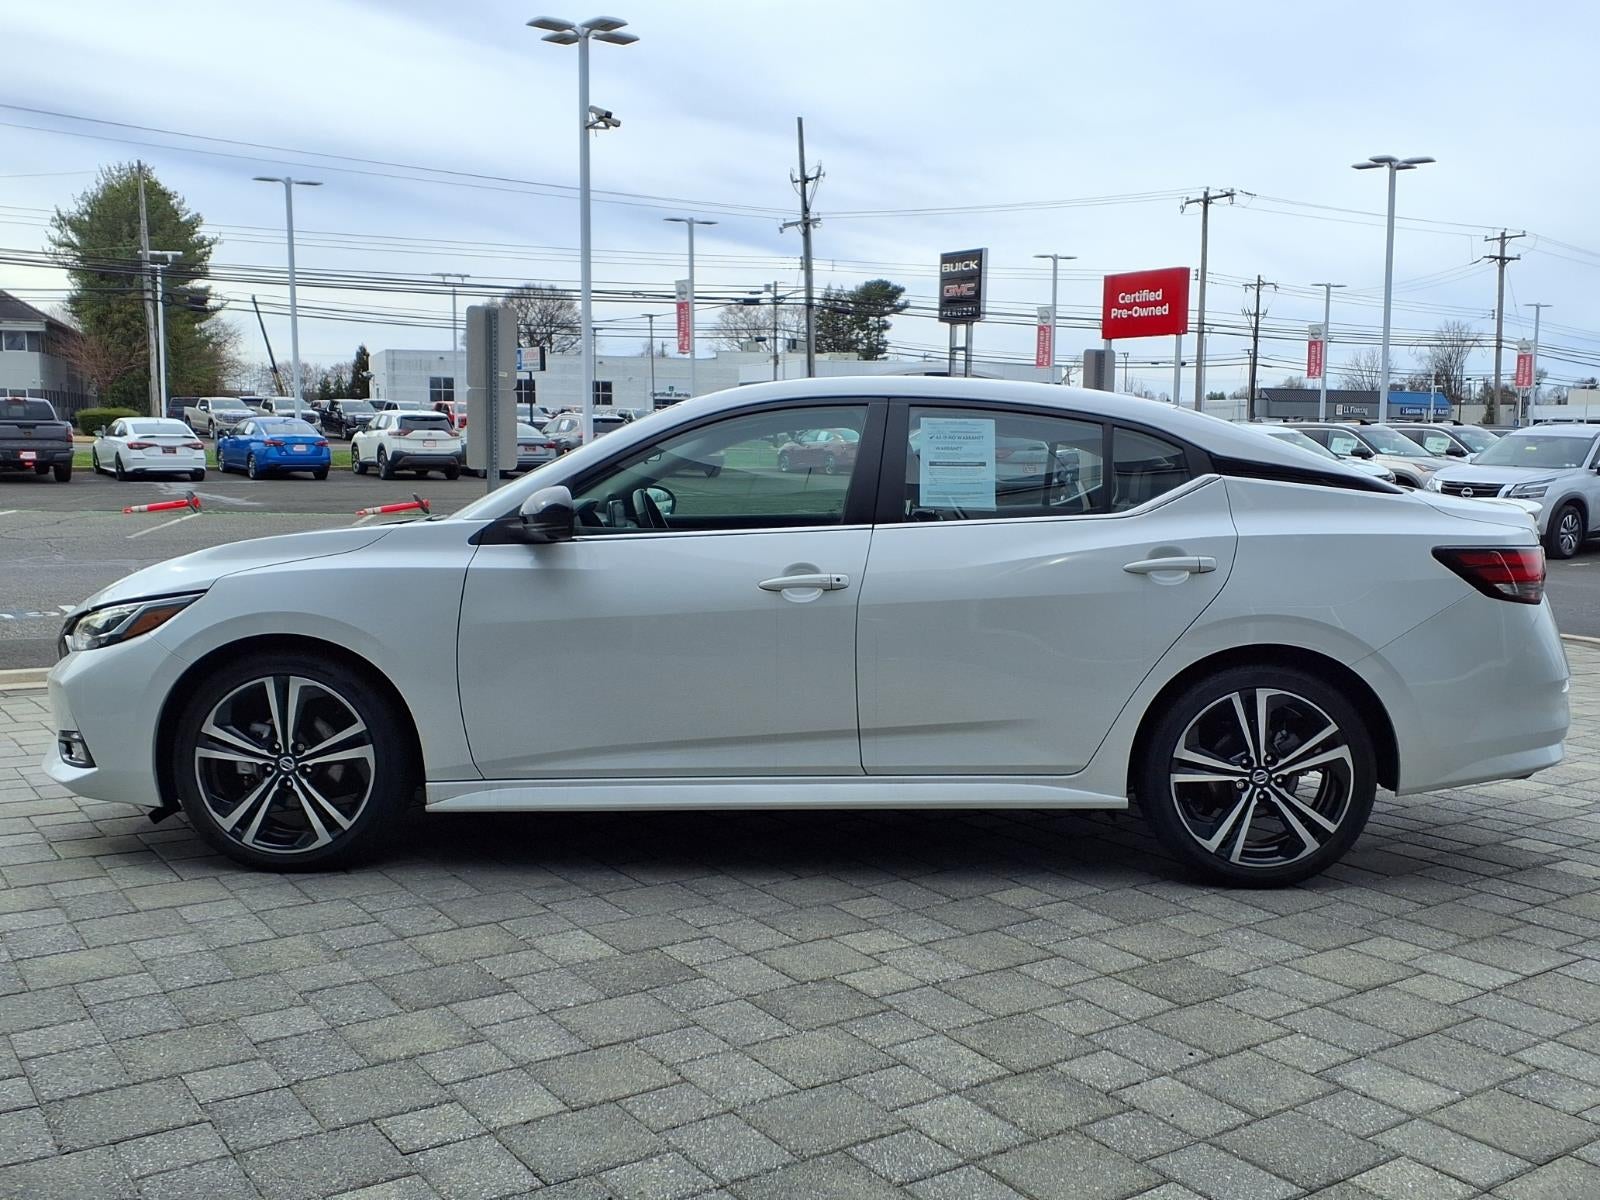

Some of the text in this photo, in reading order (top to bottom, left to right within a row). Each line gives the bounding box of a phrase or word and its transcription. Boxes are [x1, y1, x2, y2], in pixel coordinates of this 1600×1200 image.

[942, 260, 978, 272] BUICK
[944, 283, 975, 296] GMC
[1119, 288, 1163, 303] Certified
[1111, 303, 1169, 319] Pre-Owned
